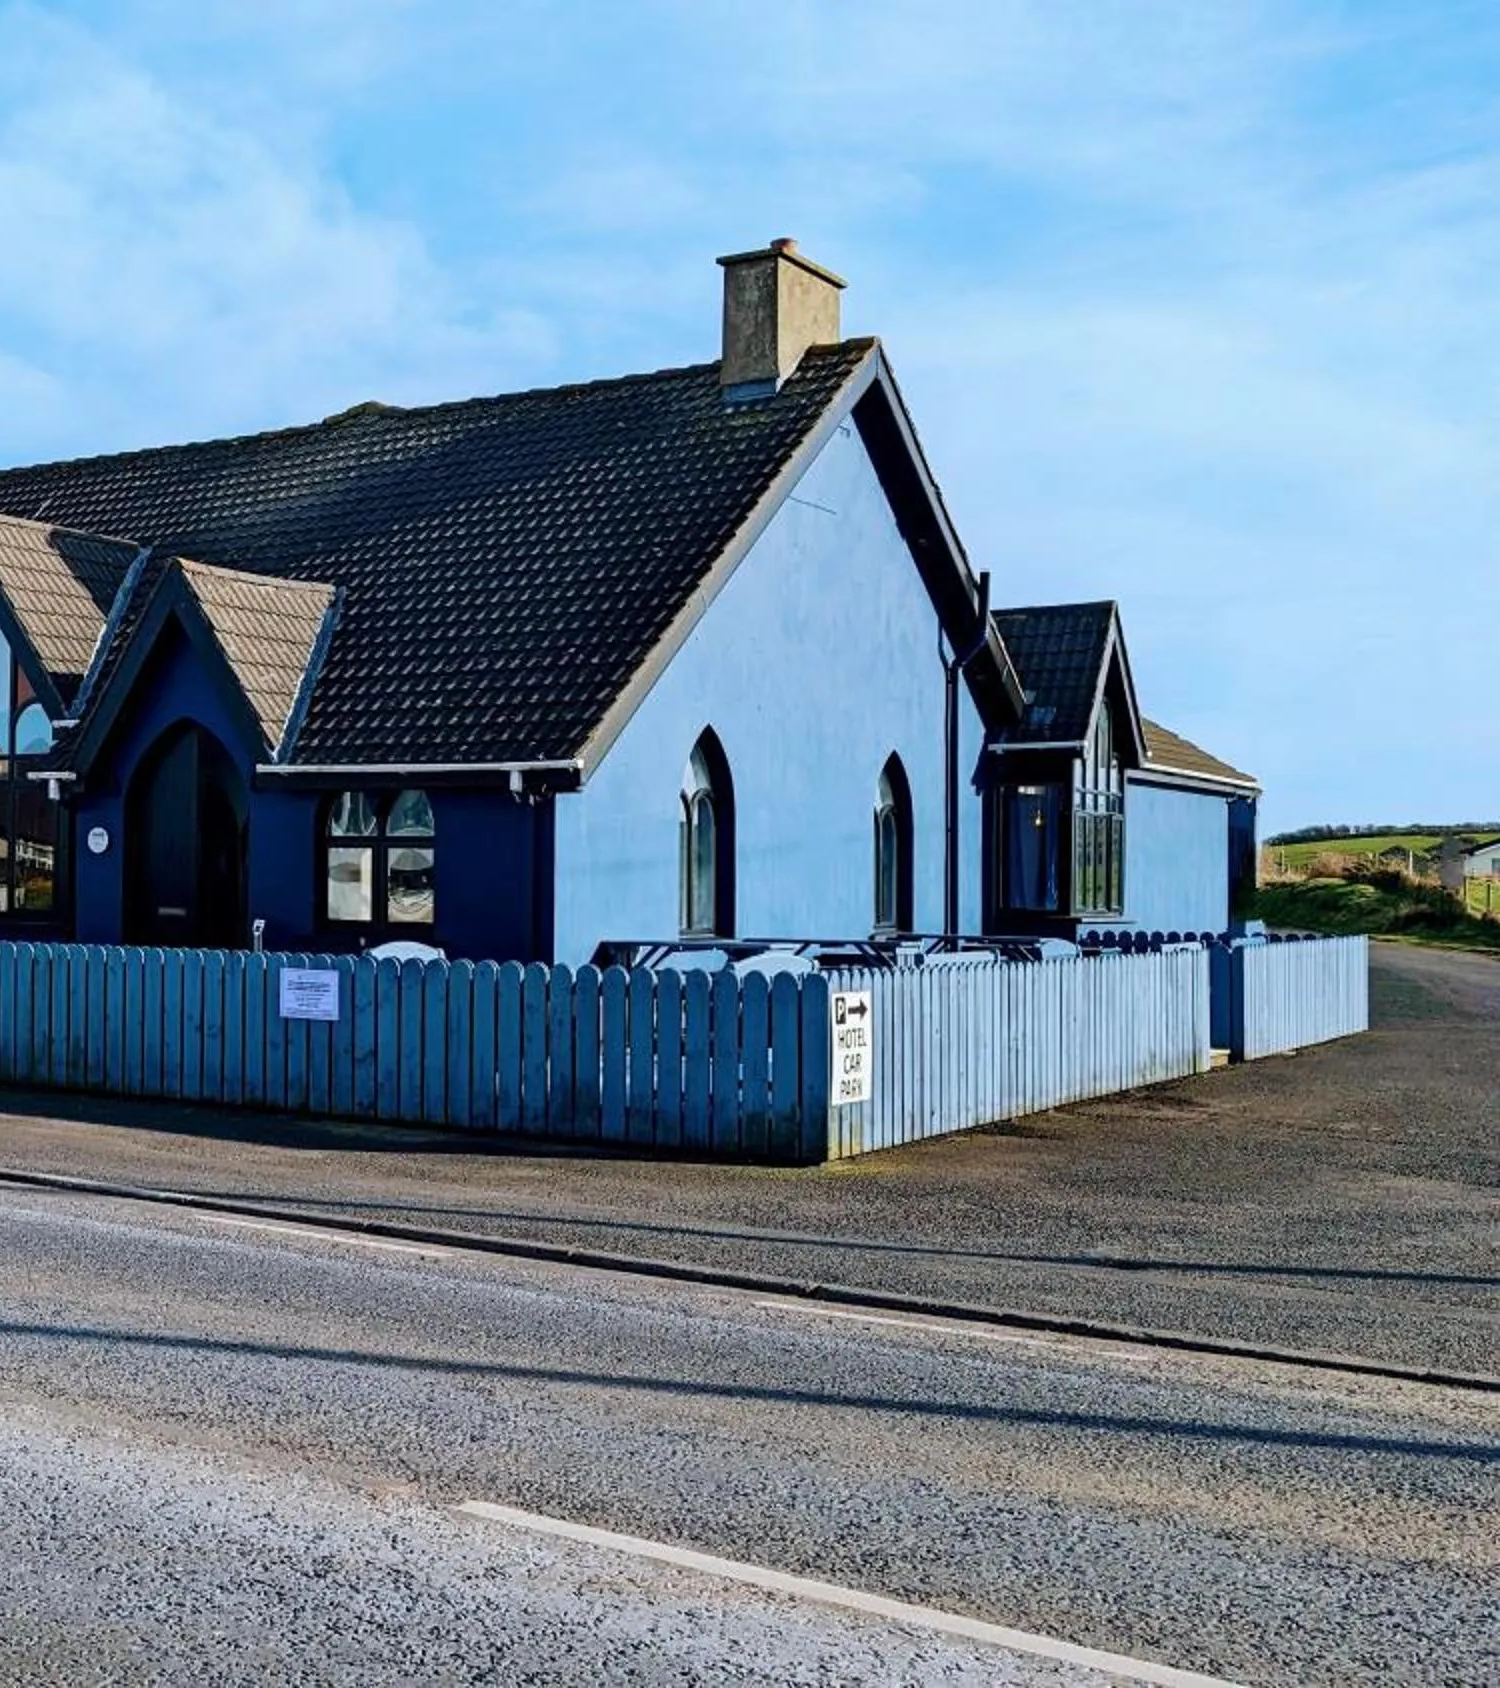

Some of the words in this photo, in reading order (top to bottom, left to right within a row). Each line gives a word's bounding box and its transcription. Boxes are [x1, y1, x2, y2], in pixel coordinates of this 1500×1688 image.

[836, 999, 846, 1023] P
[838, 1028, 867, 1049] HOTEL
[843, 1053, 861, 1075] CAR
[840, 1078, 862, 1099] PARK
